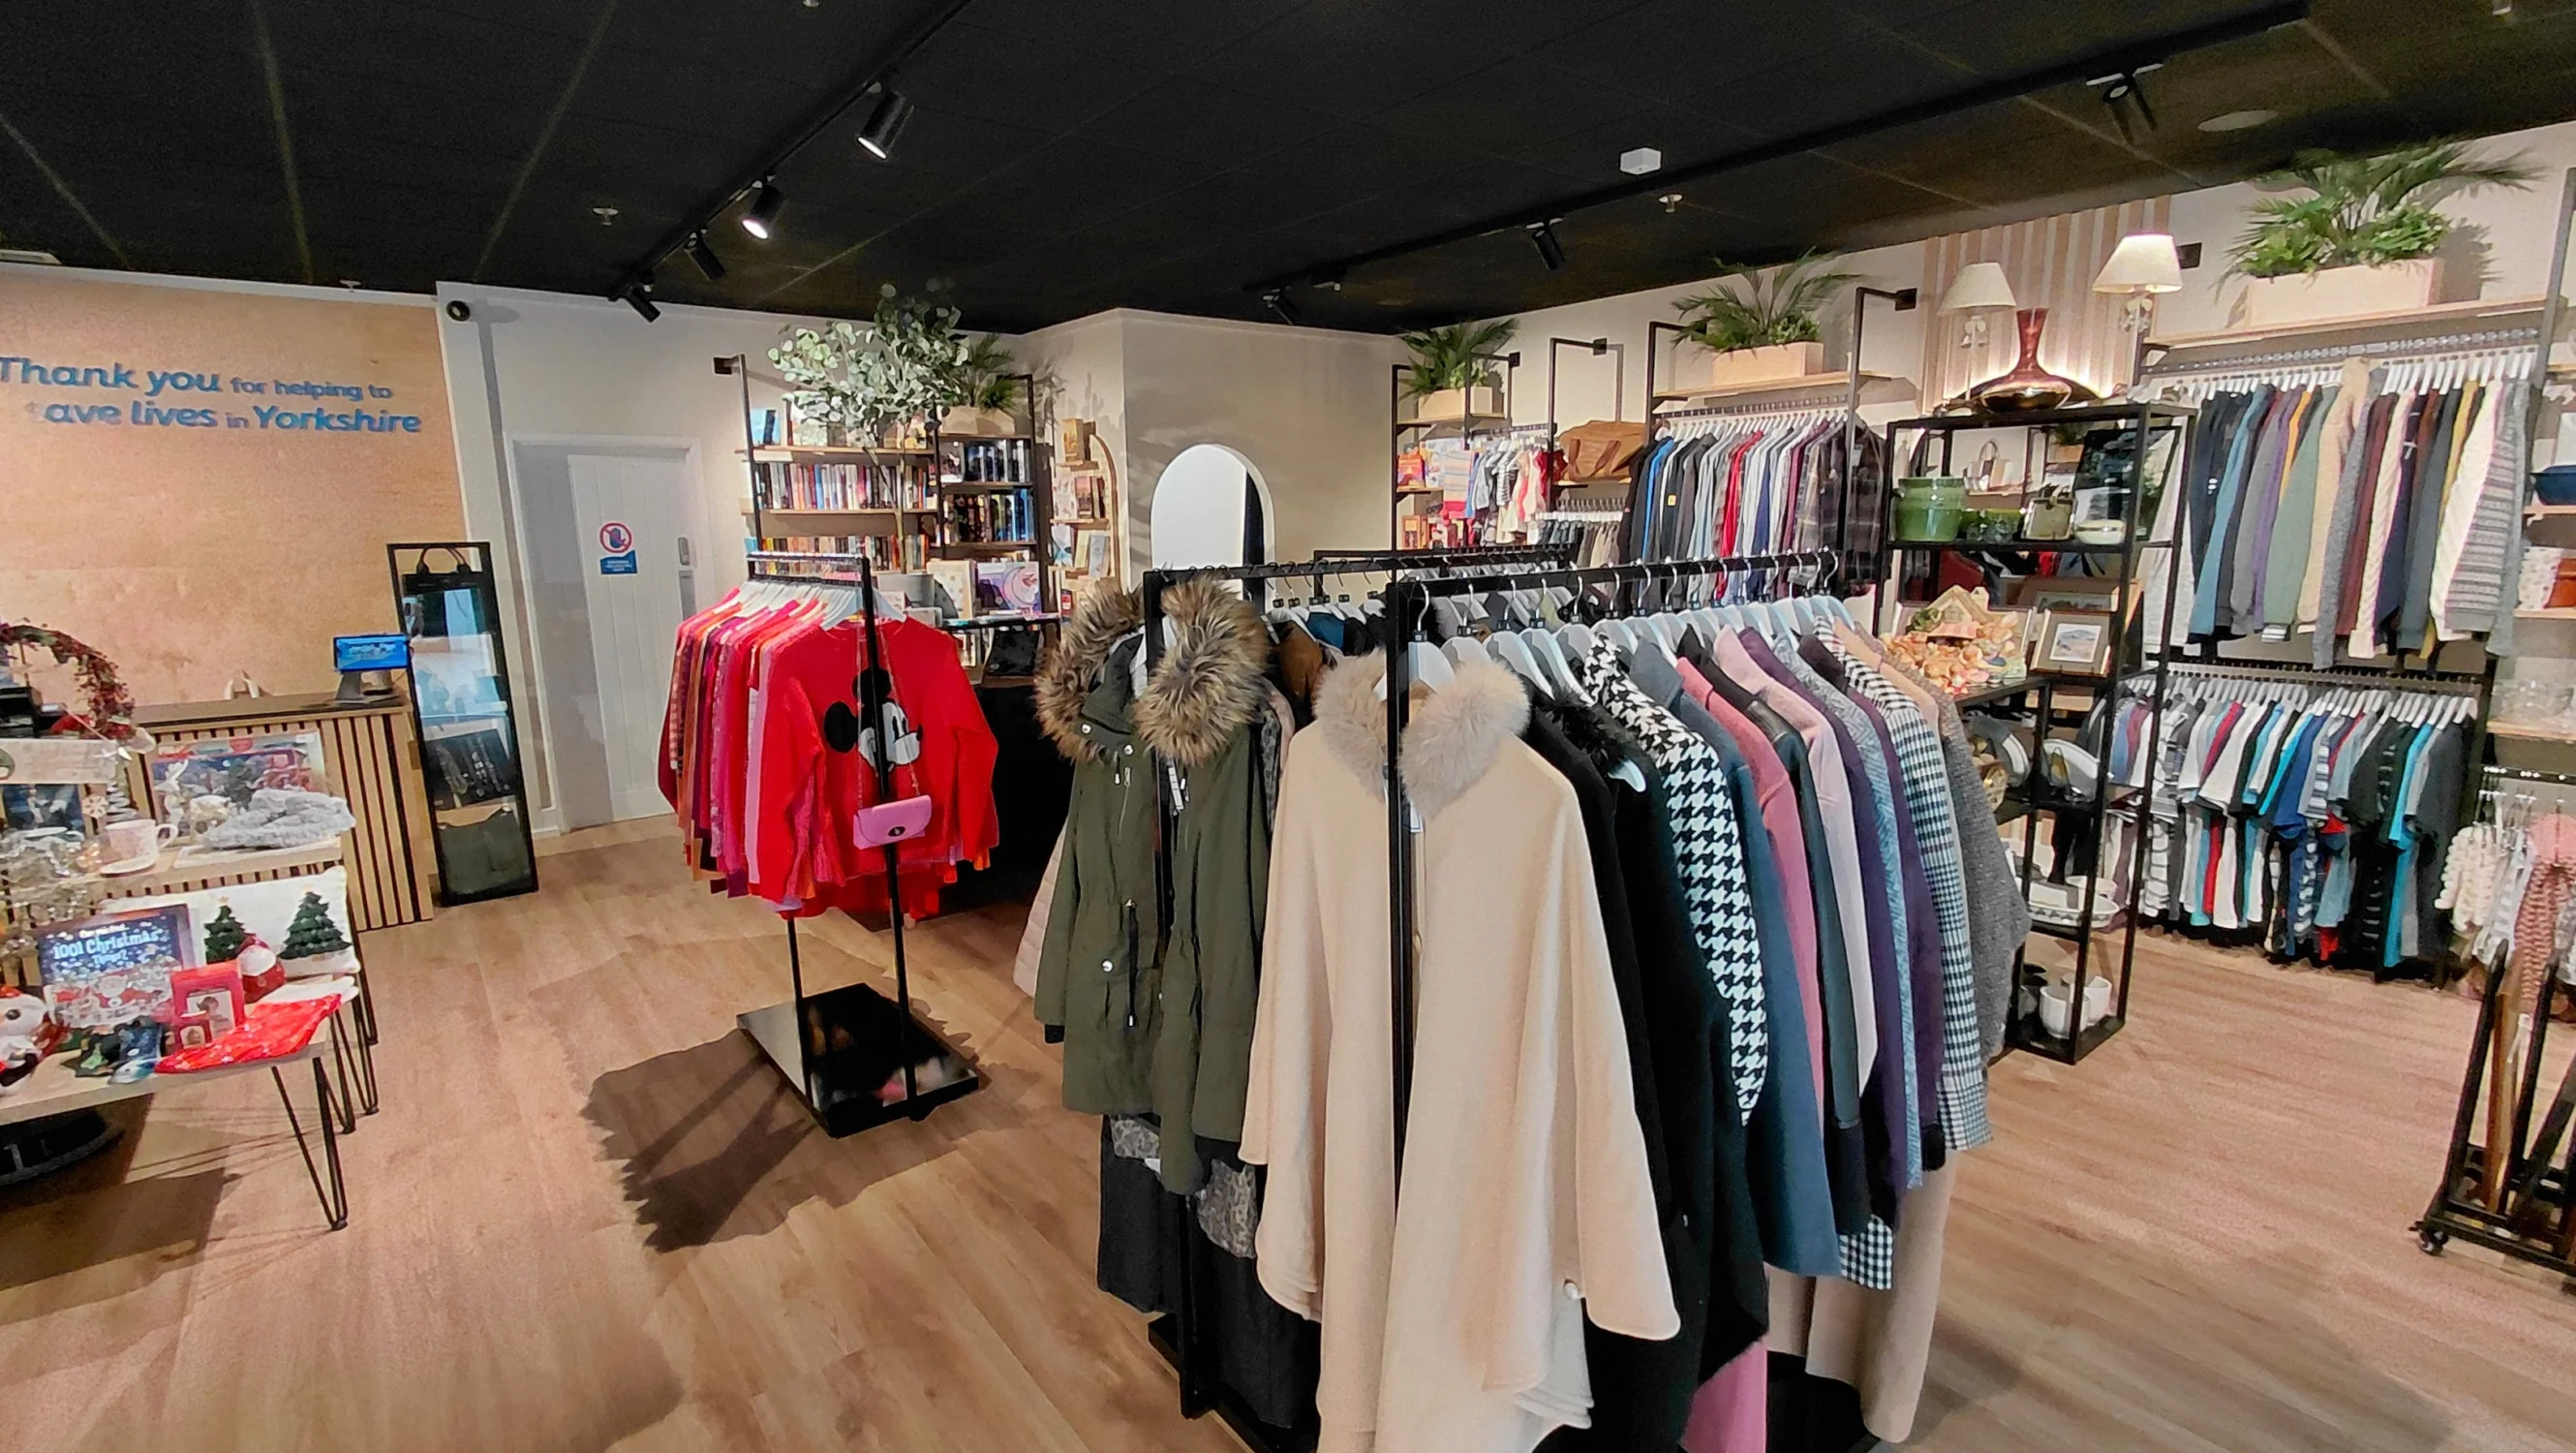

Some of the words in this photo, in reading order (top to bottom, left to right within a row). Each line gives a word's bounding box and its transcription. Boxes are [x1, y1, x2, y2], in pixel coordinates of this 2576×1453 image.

[0, 356, 139, 388] Thank
[144, 370, 223, 396] you
[230, 377, 267, 394] for
[273, 380, 363, 401] helping
[368, 385, 394, 399] to
[26, 402, 121, 424] ave
[131, 400, 218, 427] lives
[225, 412, 249, 428] in
[253, 405, 421, 432] Yorkshire
[85, 928, 163, 954] Christmas
